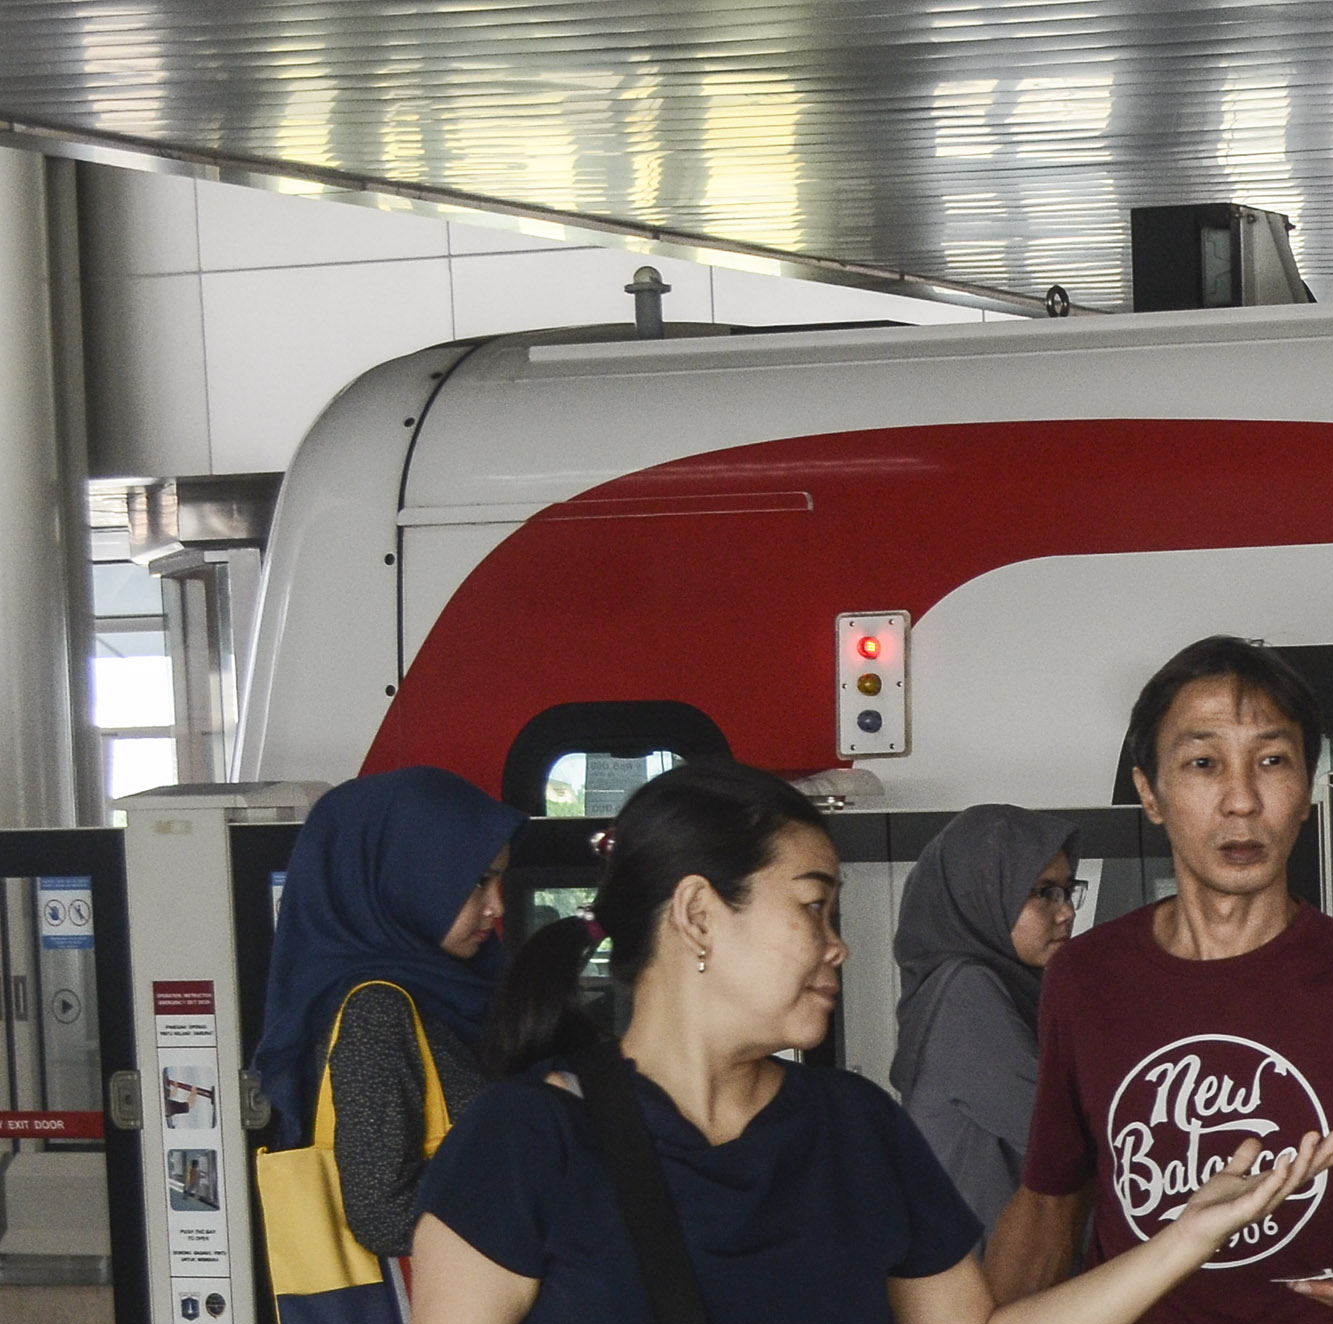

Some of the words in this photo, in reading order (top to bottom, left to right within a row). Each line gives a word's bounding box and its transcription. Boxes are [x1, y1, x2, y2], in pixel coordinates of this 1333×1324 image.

[7, 1120, 29, 1130] EXIT
[35, 1120, 65, 1130] DOOR
[1145, 1054, 1287, 1136] New
[1113, 1118, 1299, 1216] Balace
